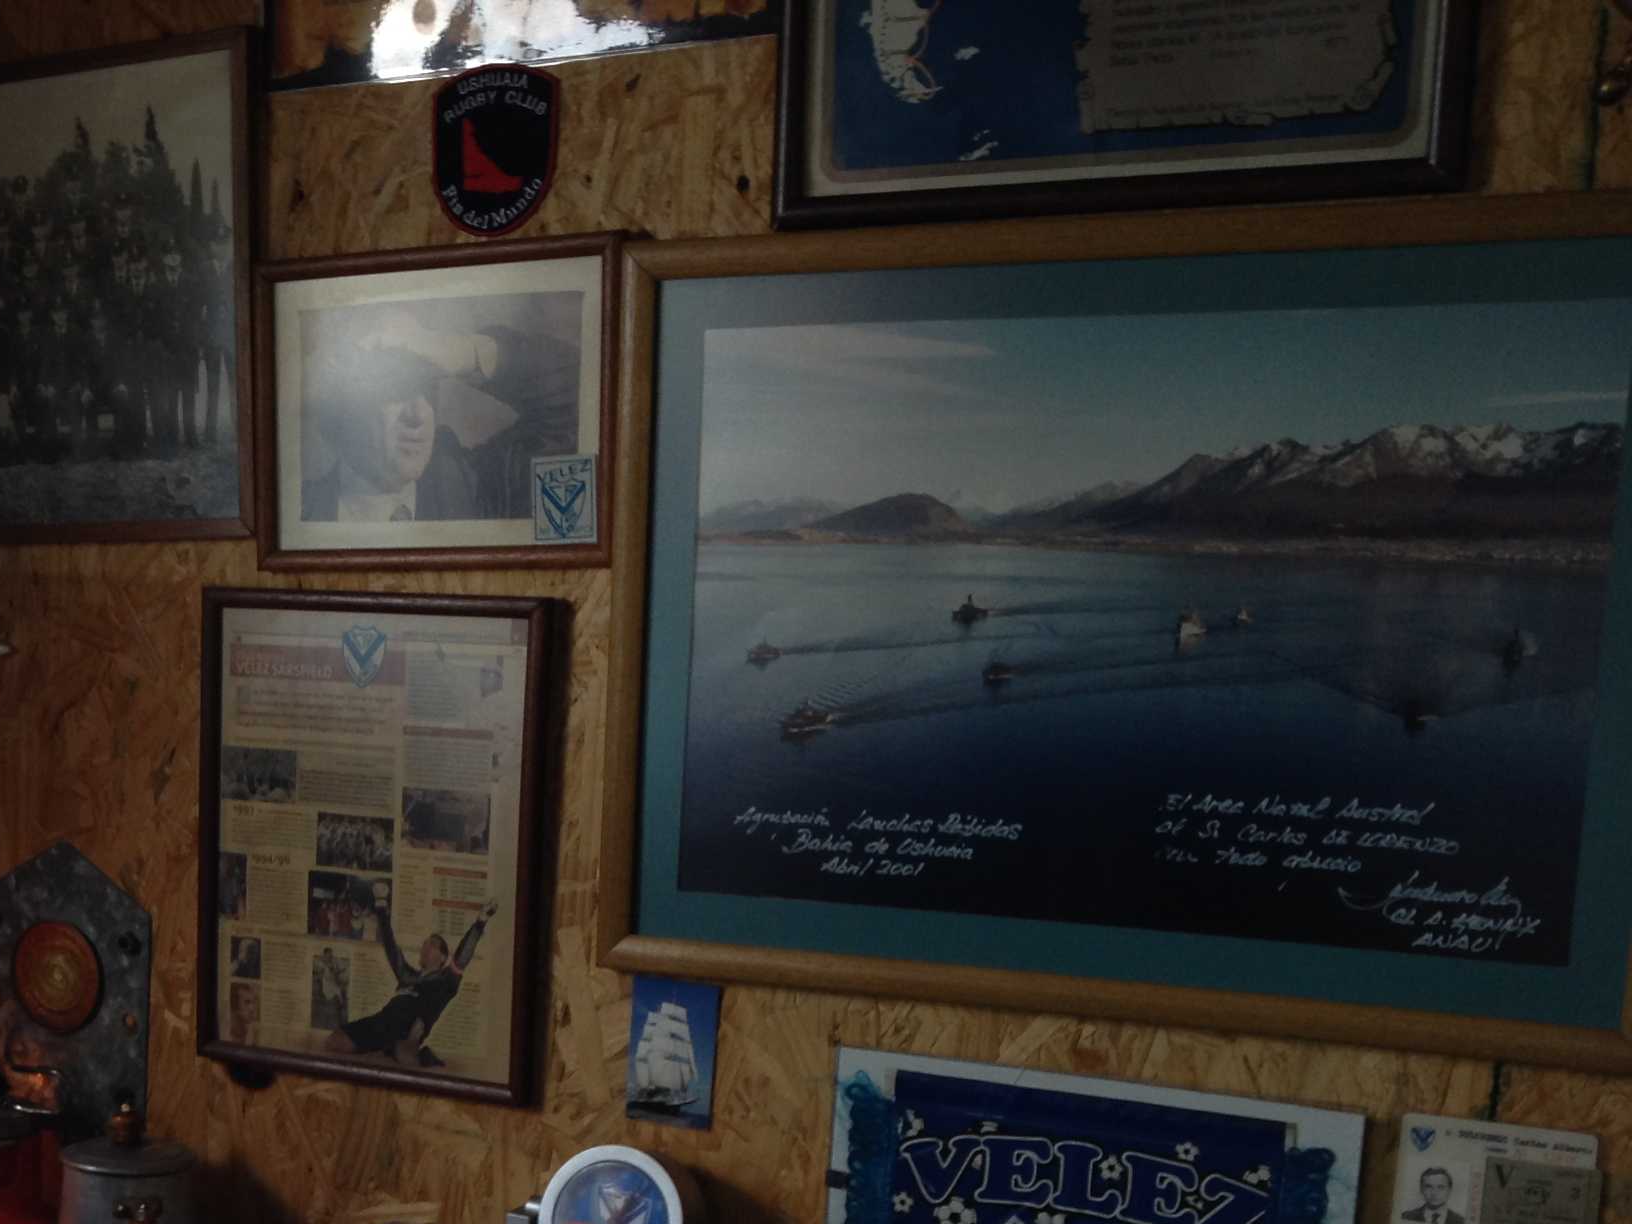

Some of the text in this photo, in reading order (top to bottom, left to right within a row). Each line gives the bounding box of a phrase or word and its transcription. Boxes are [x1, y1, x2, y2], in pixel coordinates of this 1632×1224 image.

[457, 70, 529, 94] USHUAIA
[443, 89, 548, 124] RUGBY CLUB
[486, 177, 544, 227] Mundo
[1237, 823, 1308, 845] Carlos
[864, 837, 890, 855] de
[819, 856, 926, 878] Abril 2001
